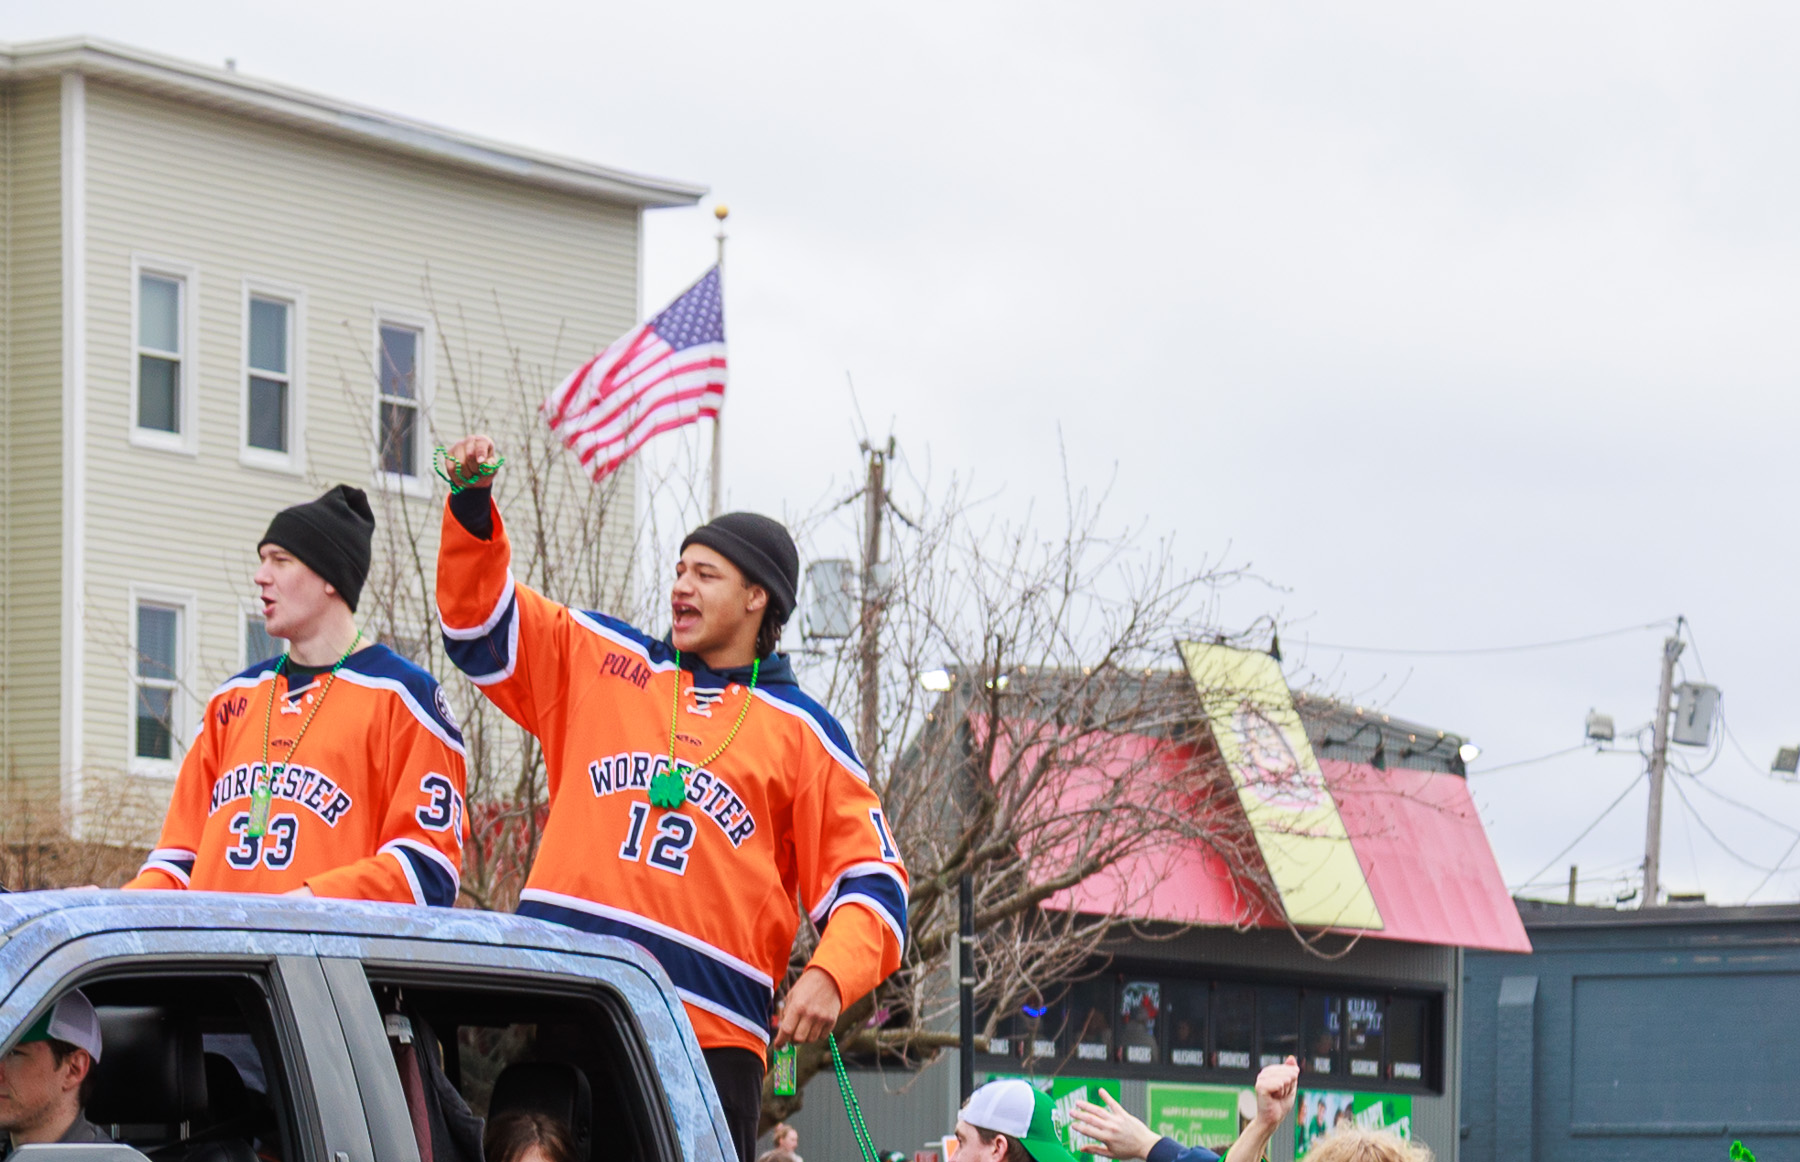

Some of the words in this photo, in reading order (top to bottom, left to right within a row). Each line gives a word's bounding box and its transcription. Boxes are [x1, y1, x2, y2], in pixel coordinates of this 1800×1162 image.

[600, 652, 652, 690] POLAR
[589, 752, 755, 848] WORCSTER
[225, 812, 299, 870] 33
[619, 802, 697, 876] 12
